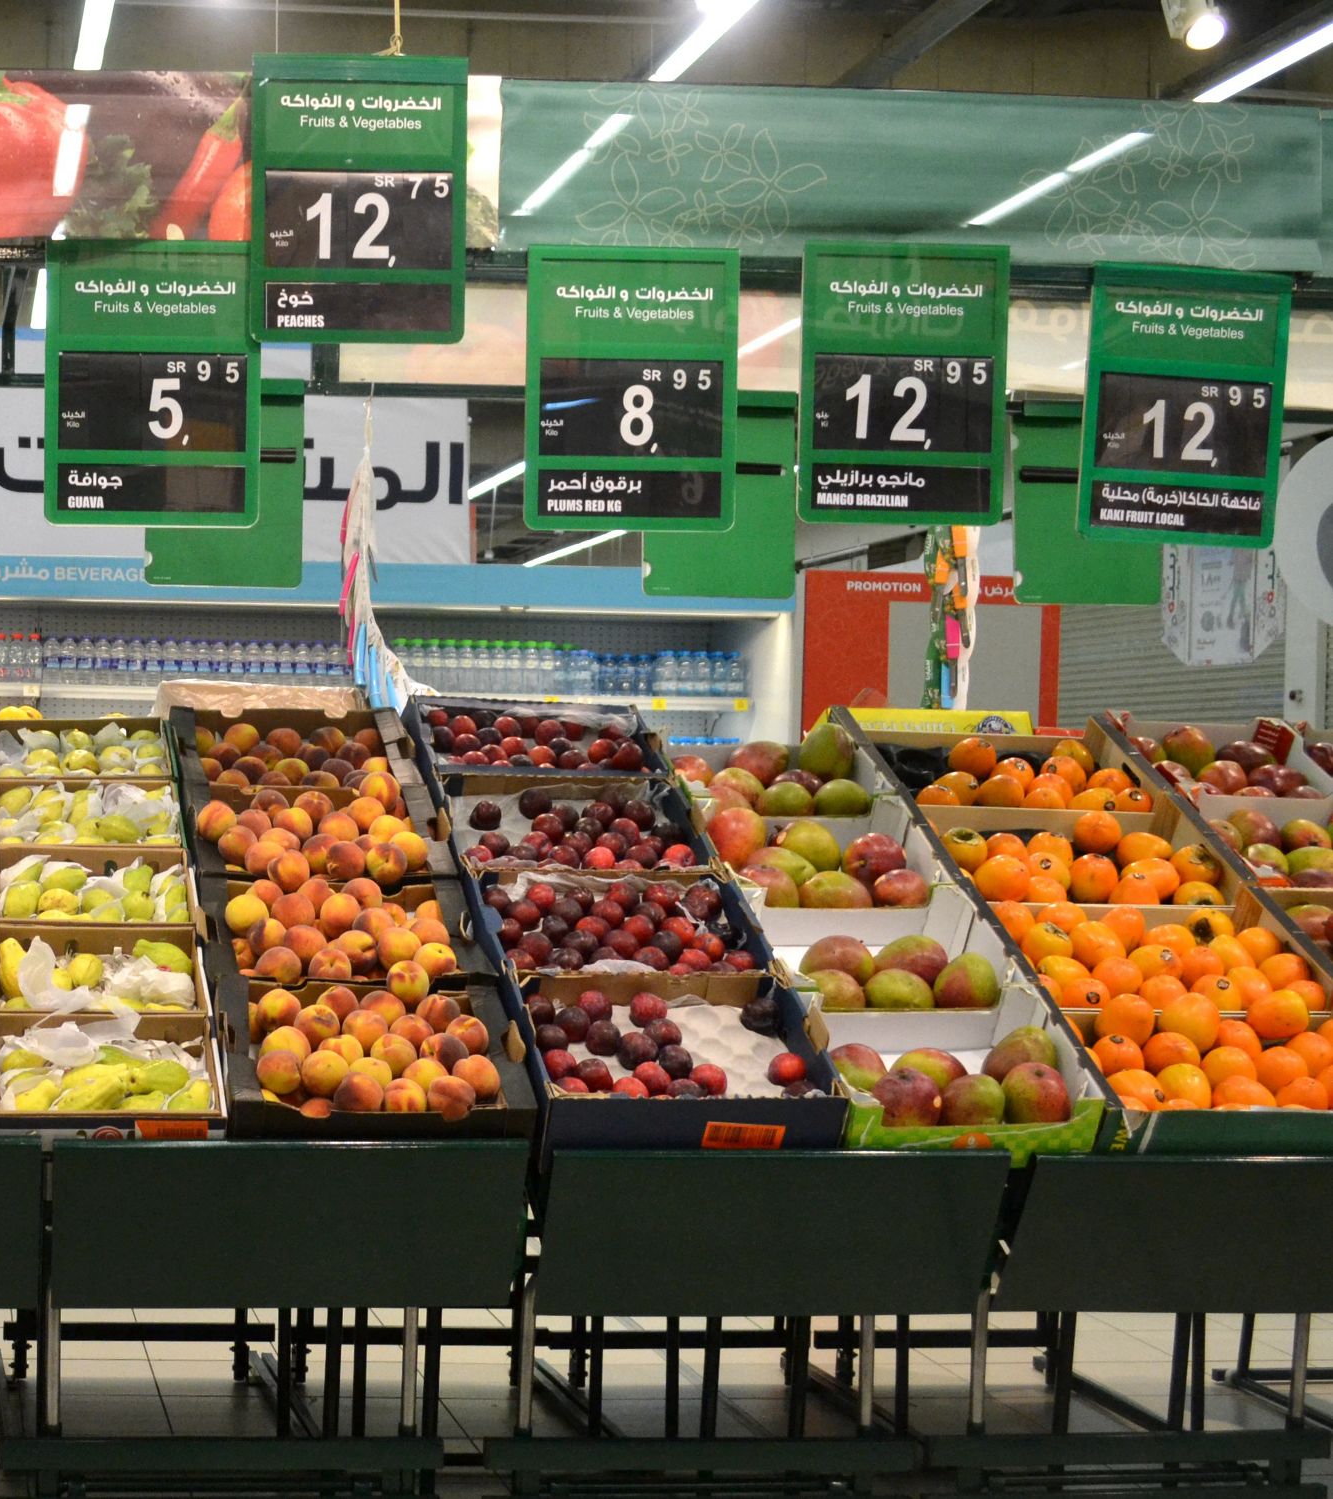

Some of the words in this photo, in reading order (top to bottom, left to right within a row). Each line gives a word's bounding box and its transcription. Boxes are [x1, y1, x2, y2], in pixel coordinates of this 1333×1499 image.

[281, 93, 341, 109] الفواكه
[346, 99, 355, 110] و
[362, 96, 441, 112] الخضروات
[300, 116, 335, 128] Fruits
[339, 116, 348, 128] &
[353, 117, 422, 131] Vegetables
[375, 177, 395, 187] SR
[75, 279, 135, 294] الفواكه
[140, 284, 149, 295] و
[156, 281, 236, 296] الخضروات
[557, 284, 615, 299] الفواكه
[636, 286, 713, 301] الخضروات
[830, 280, 887, 295] الفواكه
[892, 286, 900, 297] و
[907, 283, 982, 298] الخضروات
[277, 289, 313, 308] خوخ
[620, 289, 628, 300] و
[94, 301, 129, 313] Fruits
[134, 302, 142, 313] &
[147, 302, 216, 316] Vegetables
[575, 306, 609, 318] Fruits
[613, 307, 622, 319] &
[627, 307, 694, 321] Vegetables
[848, 302, 881, 314] Fruits
[885, 302, 894, 314] &
[898, 303, 964, 317] Vegetables
[1115, 301, 1172, 317] الفواكه
[1176, 308, 1183, 319] و
[1191, 305, 1263, 322] الخضروات
[277, 315, 324, 328] PEACHES
[1132, 322, 1164, 335] Fruits
[1168, 324, 1177, 335] &
[1181, 325, 1244, 340] Vegetables
[167, 362, 186, 372] SR
[914, 360, 934, 372] SR
[643, 370, 661, 381] SR
[1201, 386, 1218, 397] SR
[68, 470, 122, 489] جوافة
[548, 472, 587, 492] أحمر
[590, 477, 642, 494] برقوق
[818, 470, 872, 490] برازيلي
[877, 473, 925, 488] مانجو
[817, 492, 854, 506] MANGO
[856, 493, 908, 508] BRAZILIAN
[1102, 483, 1139, 504] محلية
[68, 496, 104, 508] GUAVA
[547, 500, 583, 511] PLUMS
[585, 500, 605, 512] RED
[607, 501, 622, 512] KG
[1100, 508, 1124, 521] KAKI
[1126, 510, 1154, 524] FRUIT
[1156, 511, 1184, 526] LOCAL
[846, 581, 921, 592] PROMOTION
